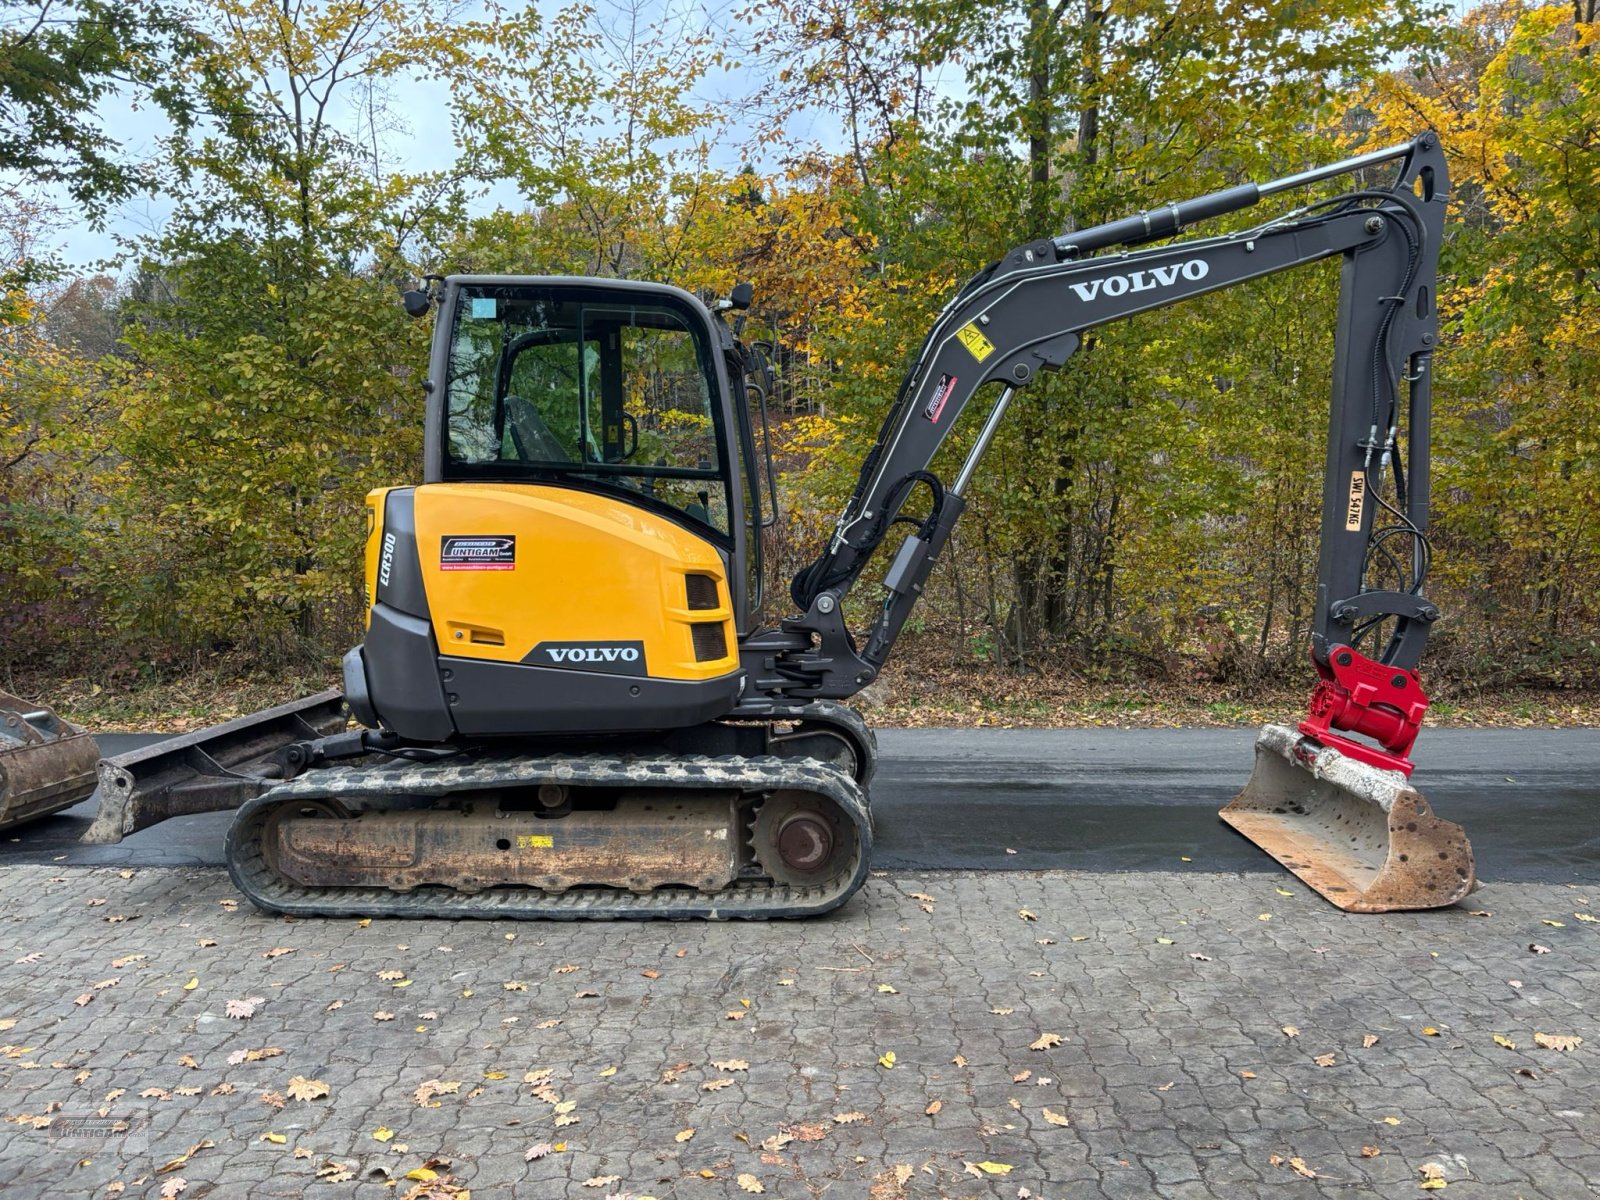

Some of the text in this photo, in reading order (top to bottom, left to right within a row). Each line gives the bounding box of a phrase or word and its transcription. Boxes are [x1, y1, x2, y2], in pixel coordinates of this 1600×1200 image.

[1068, 259, 1209, 302] VOLVO
[1348, 477, 1364, 525] SWL 547KG
[380, 532, 396, 587] ECR50D
[545, 647, 639, 662] VOLVO
